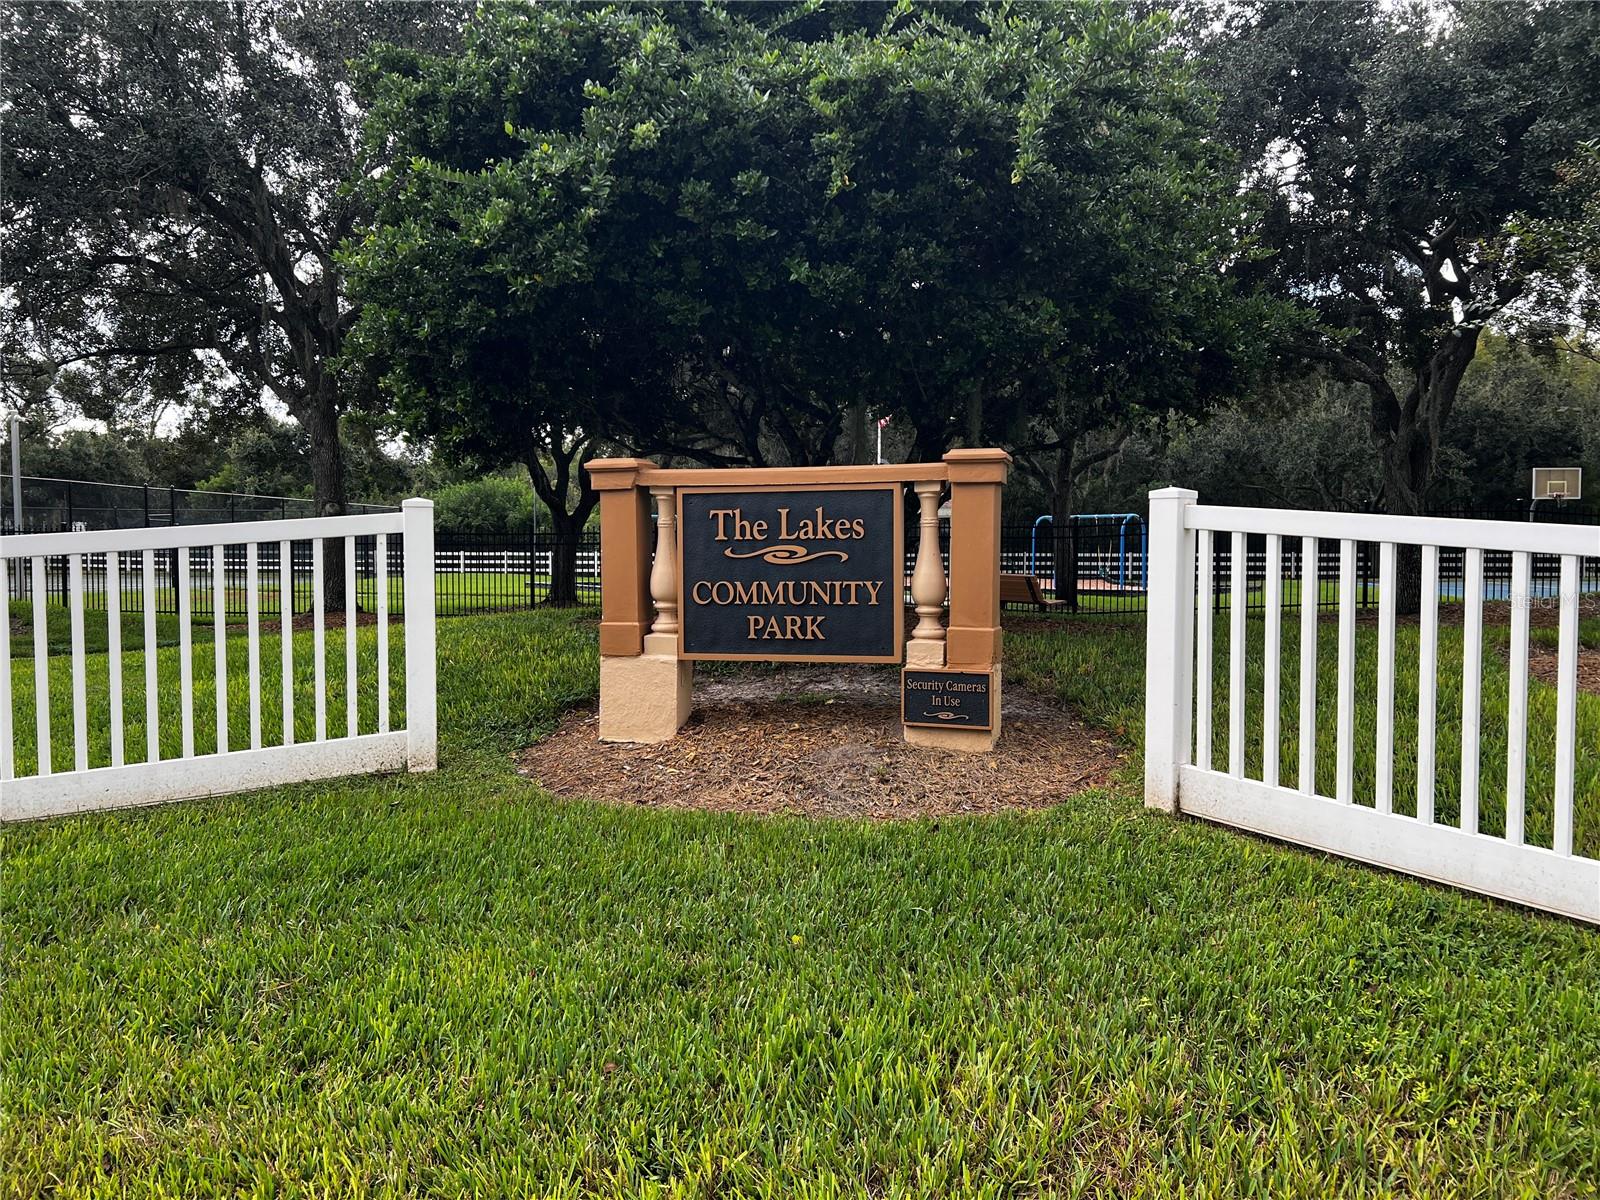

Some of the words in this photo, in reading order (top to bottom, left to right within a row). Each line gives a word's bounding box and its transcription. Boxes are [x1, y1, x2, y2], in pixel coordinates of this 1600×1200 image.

[709, 507, 768, 540] The
[777, 506, 865, 540] Lakes
[692, 581, 883, 605] COMMUNITY
[747, 615, 826, 640] PARK
[907, 679, 944, 693] Security
[946, 681, 986, 692] Cameras
[932, 695, 942, 706] In
[944, 696, 961, 707] Use
